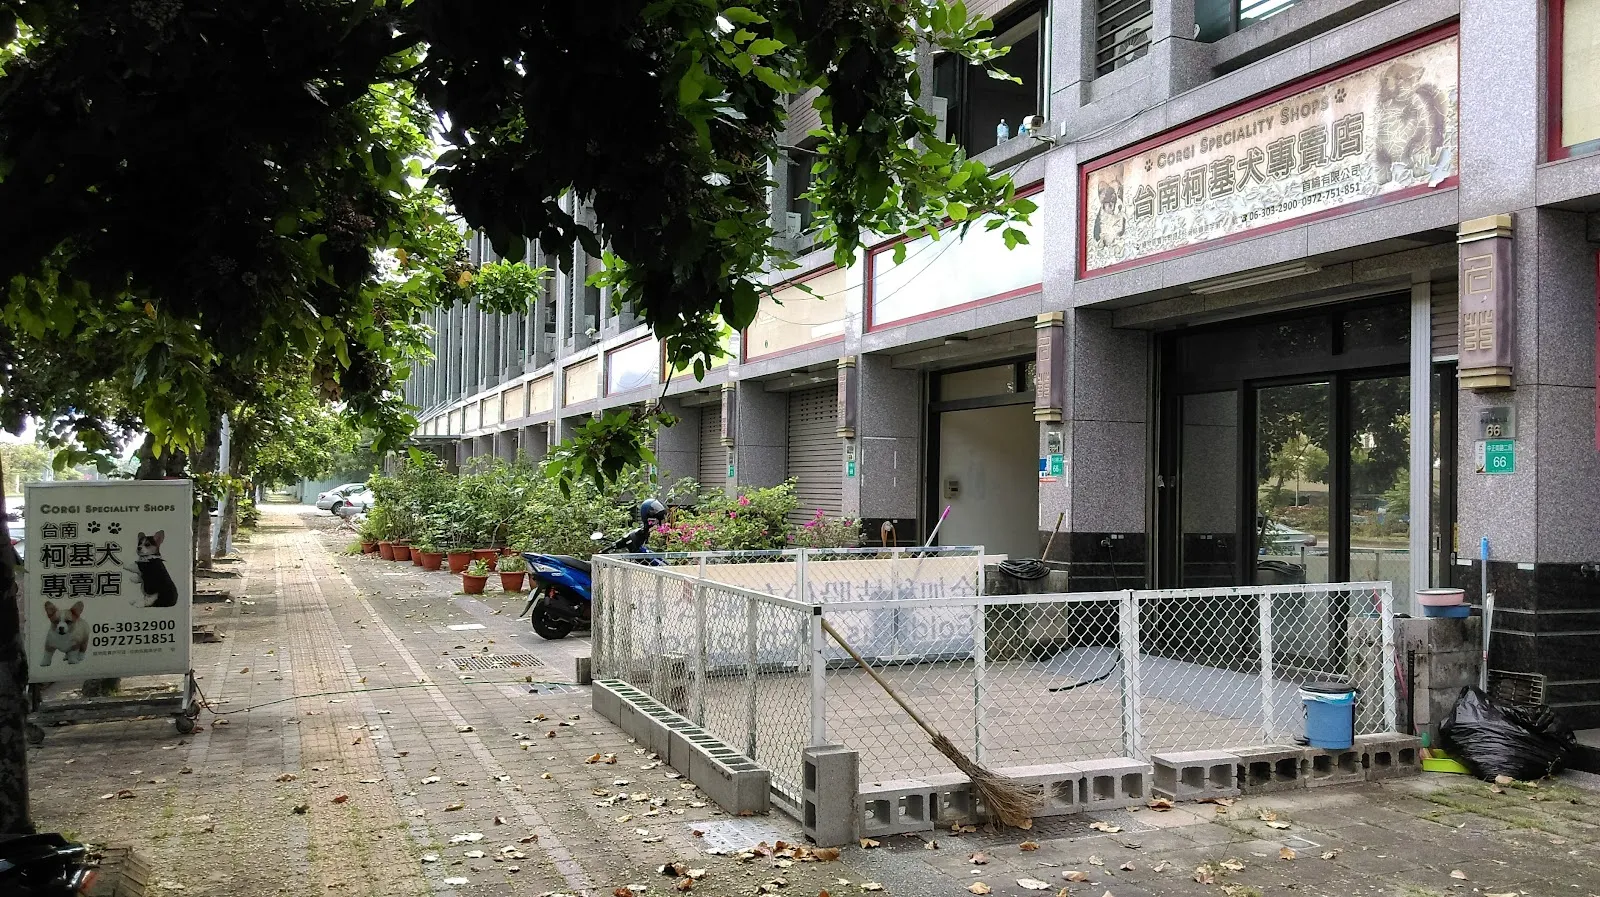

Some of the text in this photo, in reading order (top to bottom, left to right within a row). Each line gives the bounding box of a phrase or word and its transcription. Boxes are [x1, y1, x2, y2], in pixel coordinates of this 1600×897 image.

[1157, 95, 1329, 169] CORGI SPECIALITY SHOPS
[1133, 112, 1364, 221] 台南柯基犬專賣店
[1249, 182, 1360, 221] 06-303-2900 0972-751-851
[1486, 424, 1501, 437] 66
[1493, 456, 1506, 467] 66
[40, 503, 176, 514] CORGI SPECIALITY SHOPS
[41, 522, 79, 539] 台南
[40, 542, 123, 569] 柯基犬
[41, 571, 123, 599] 專賣店
[92, 620, 175, 634] 06-3032900
[92, 633, 176, 647] 0972751851
